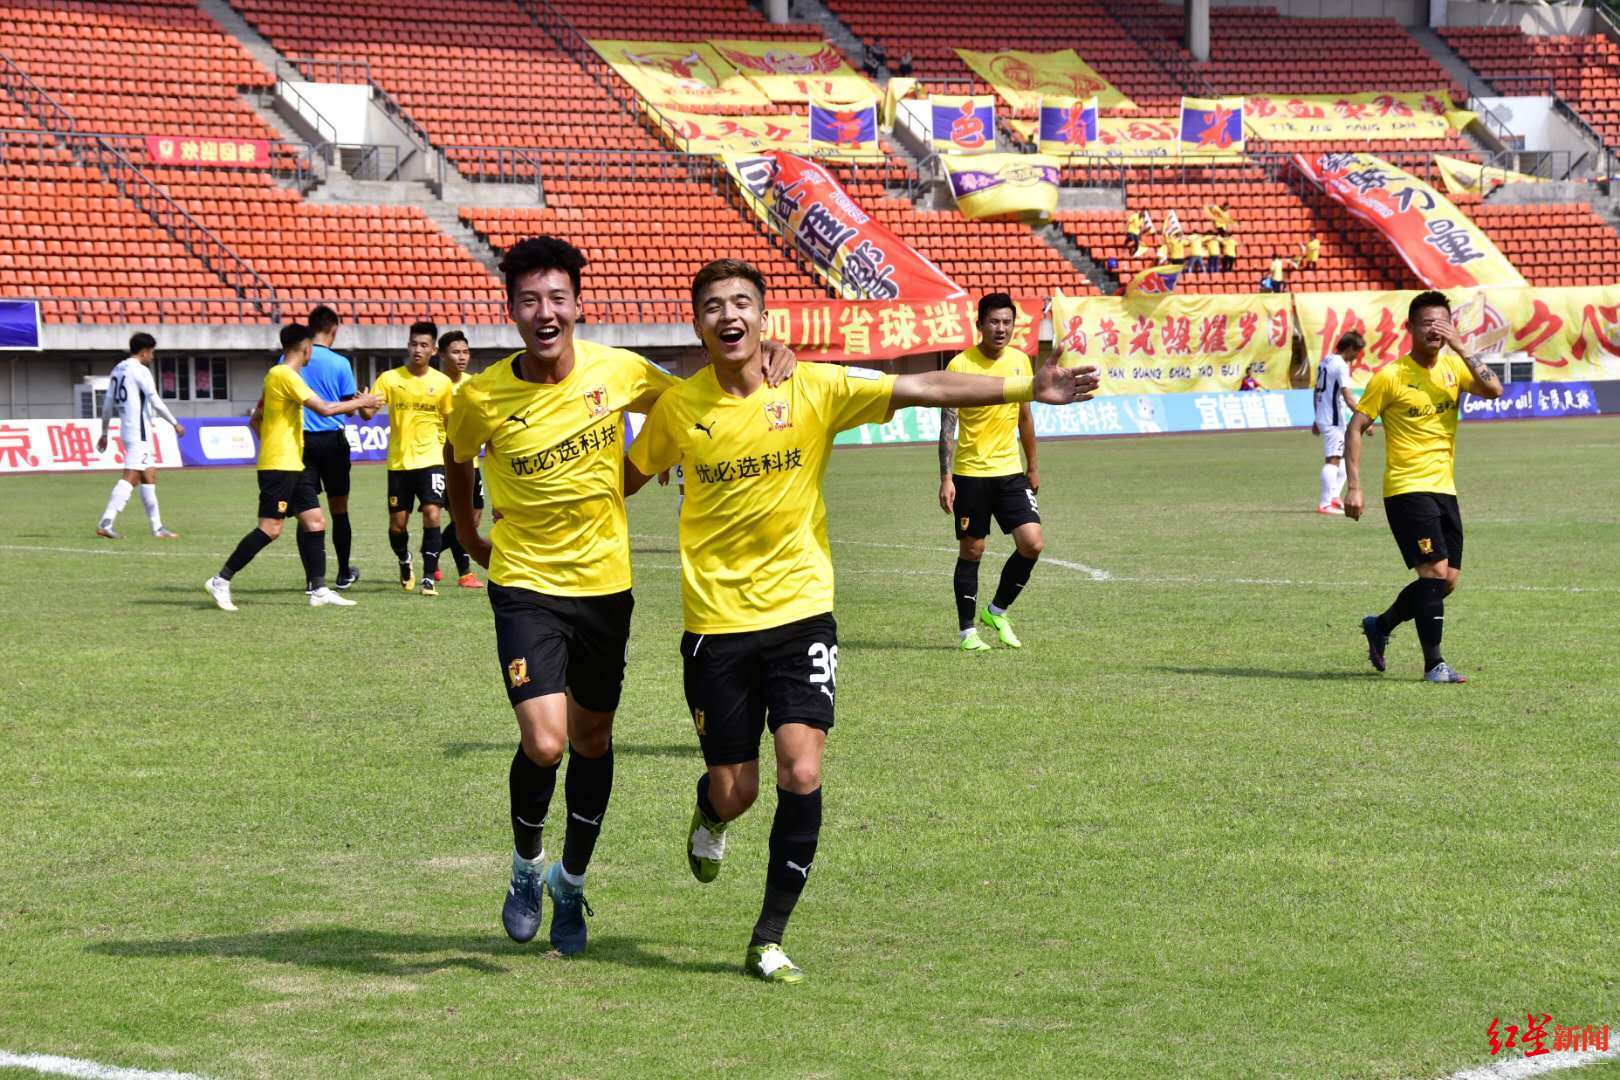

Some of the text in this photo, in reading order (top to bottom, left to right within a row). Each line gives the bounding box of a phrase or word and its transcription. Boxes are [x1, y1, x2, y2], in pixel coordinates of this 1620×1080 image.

[511, 423, 617, 476] 优必选科技
[695, 448, 802, 484] 优必选科技
